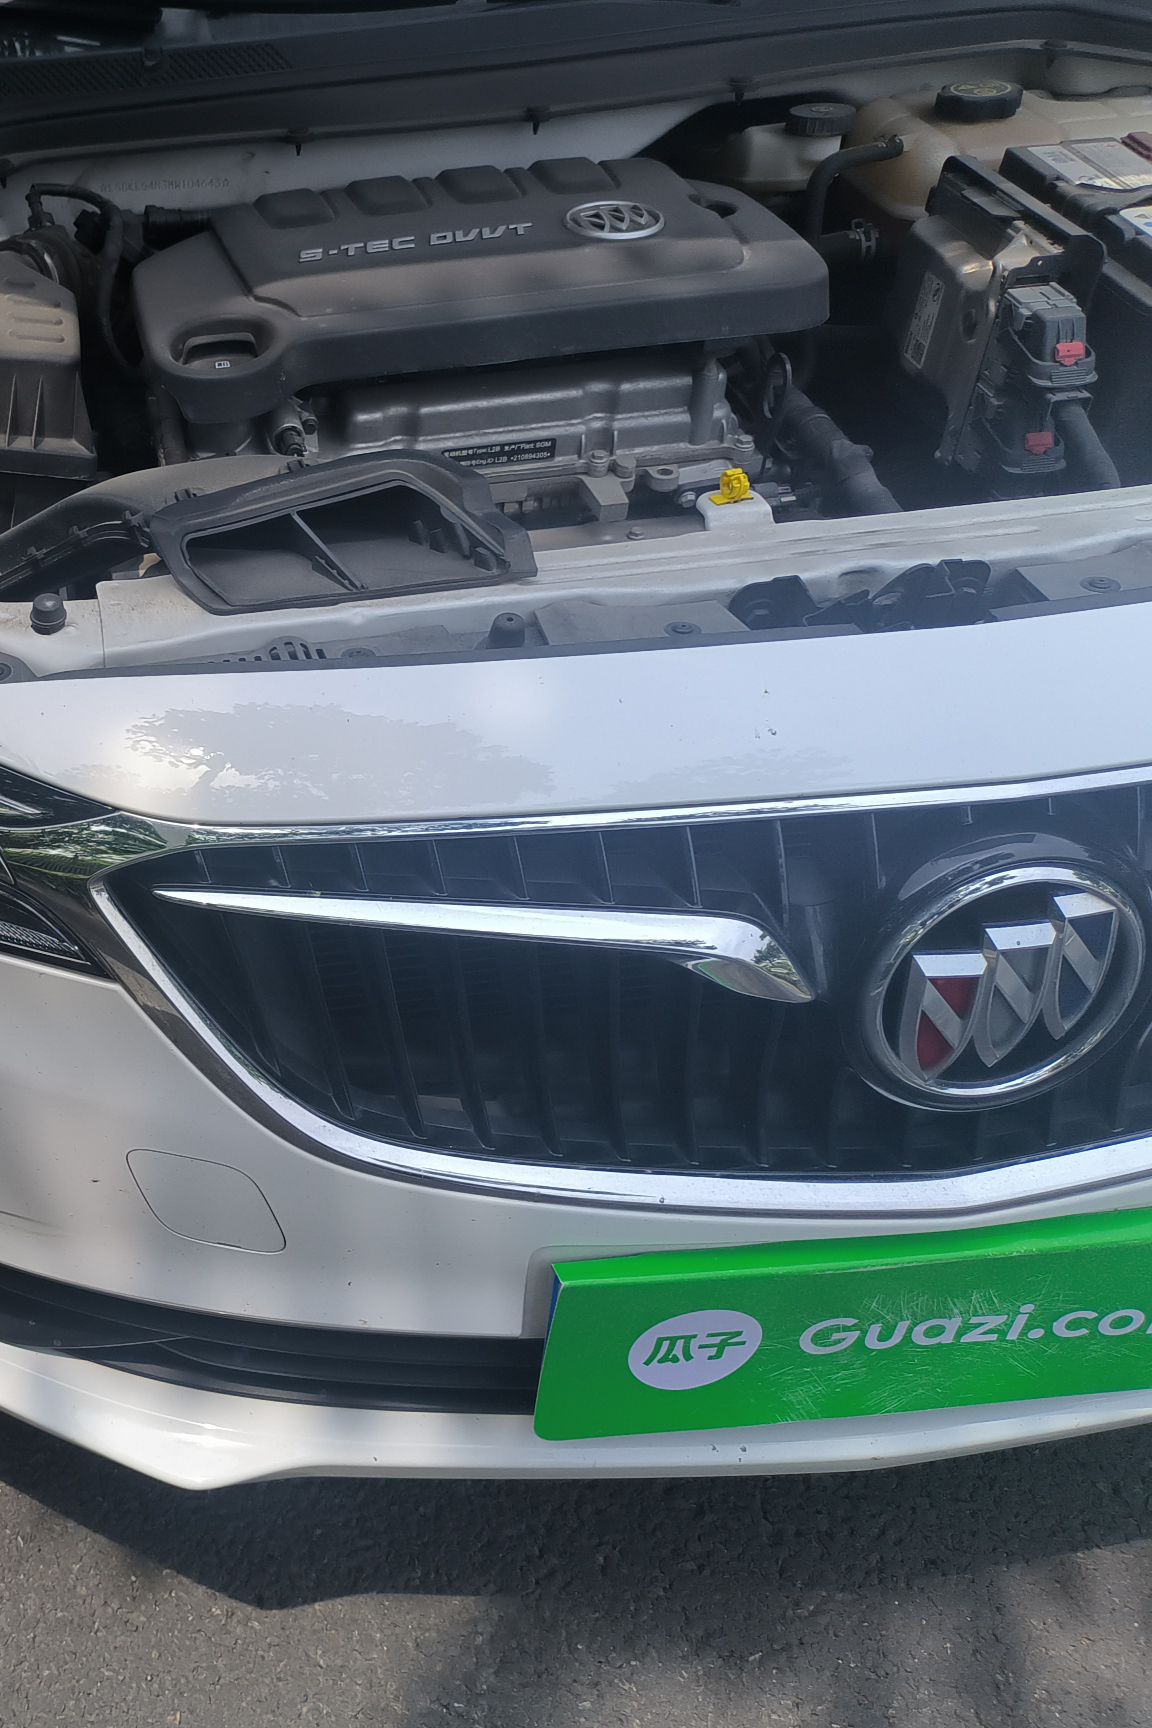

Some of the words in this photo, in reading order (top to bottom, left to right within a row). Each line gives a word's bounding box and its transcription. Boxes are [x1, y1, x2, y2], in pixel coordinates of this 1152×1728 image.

[299, 236, 415, 262] S-TEC
[430, 222, 533, 246] DVVT
[642, 1330, 748, 1367] 瓜子
[799, 1303, 1152, 1355] Guazi.co
